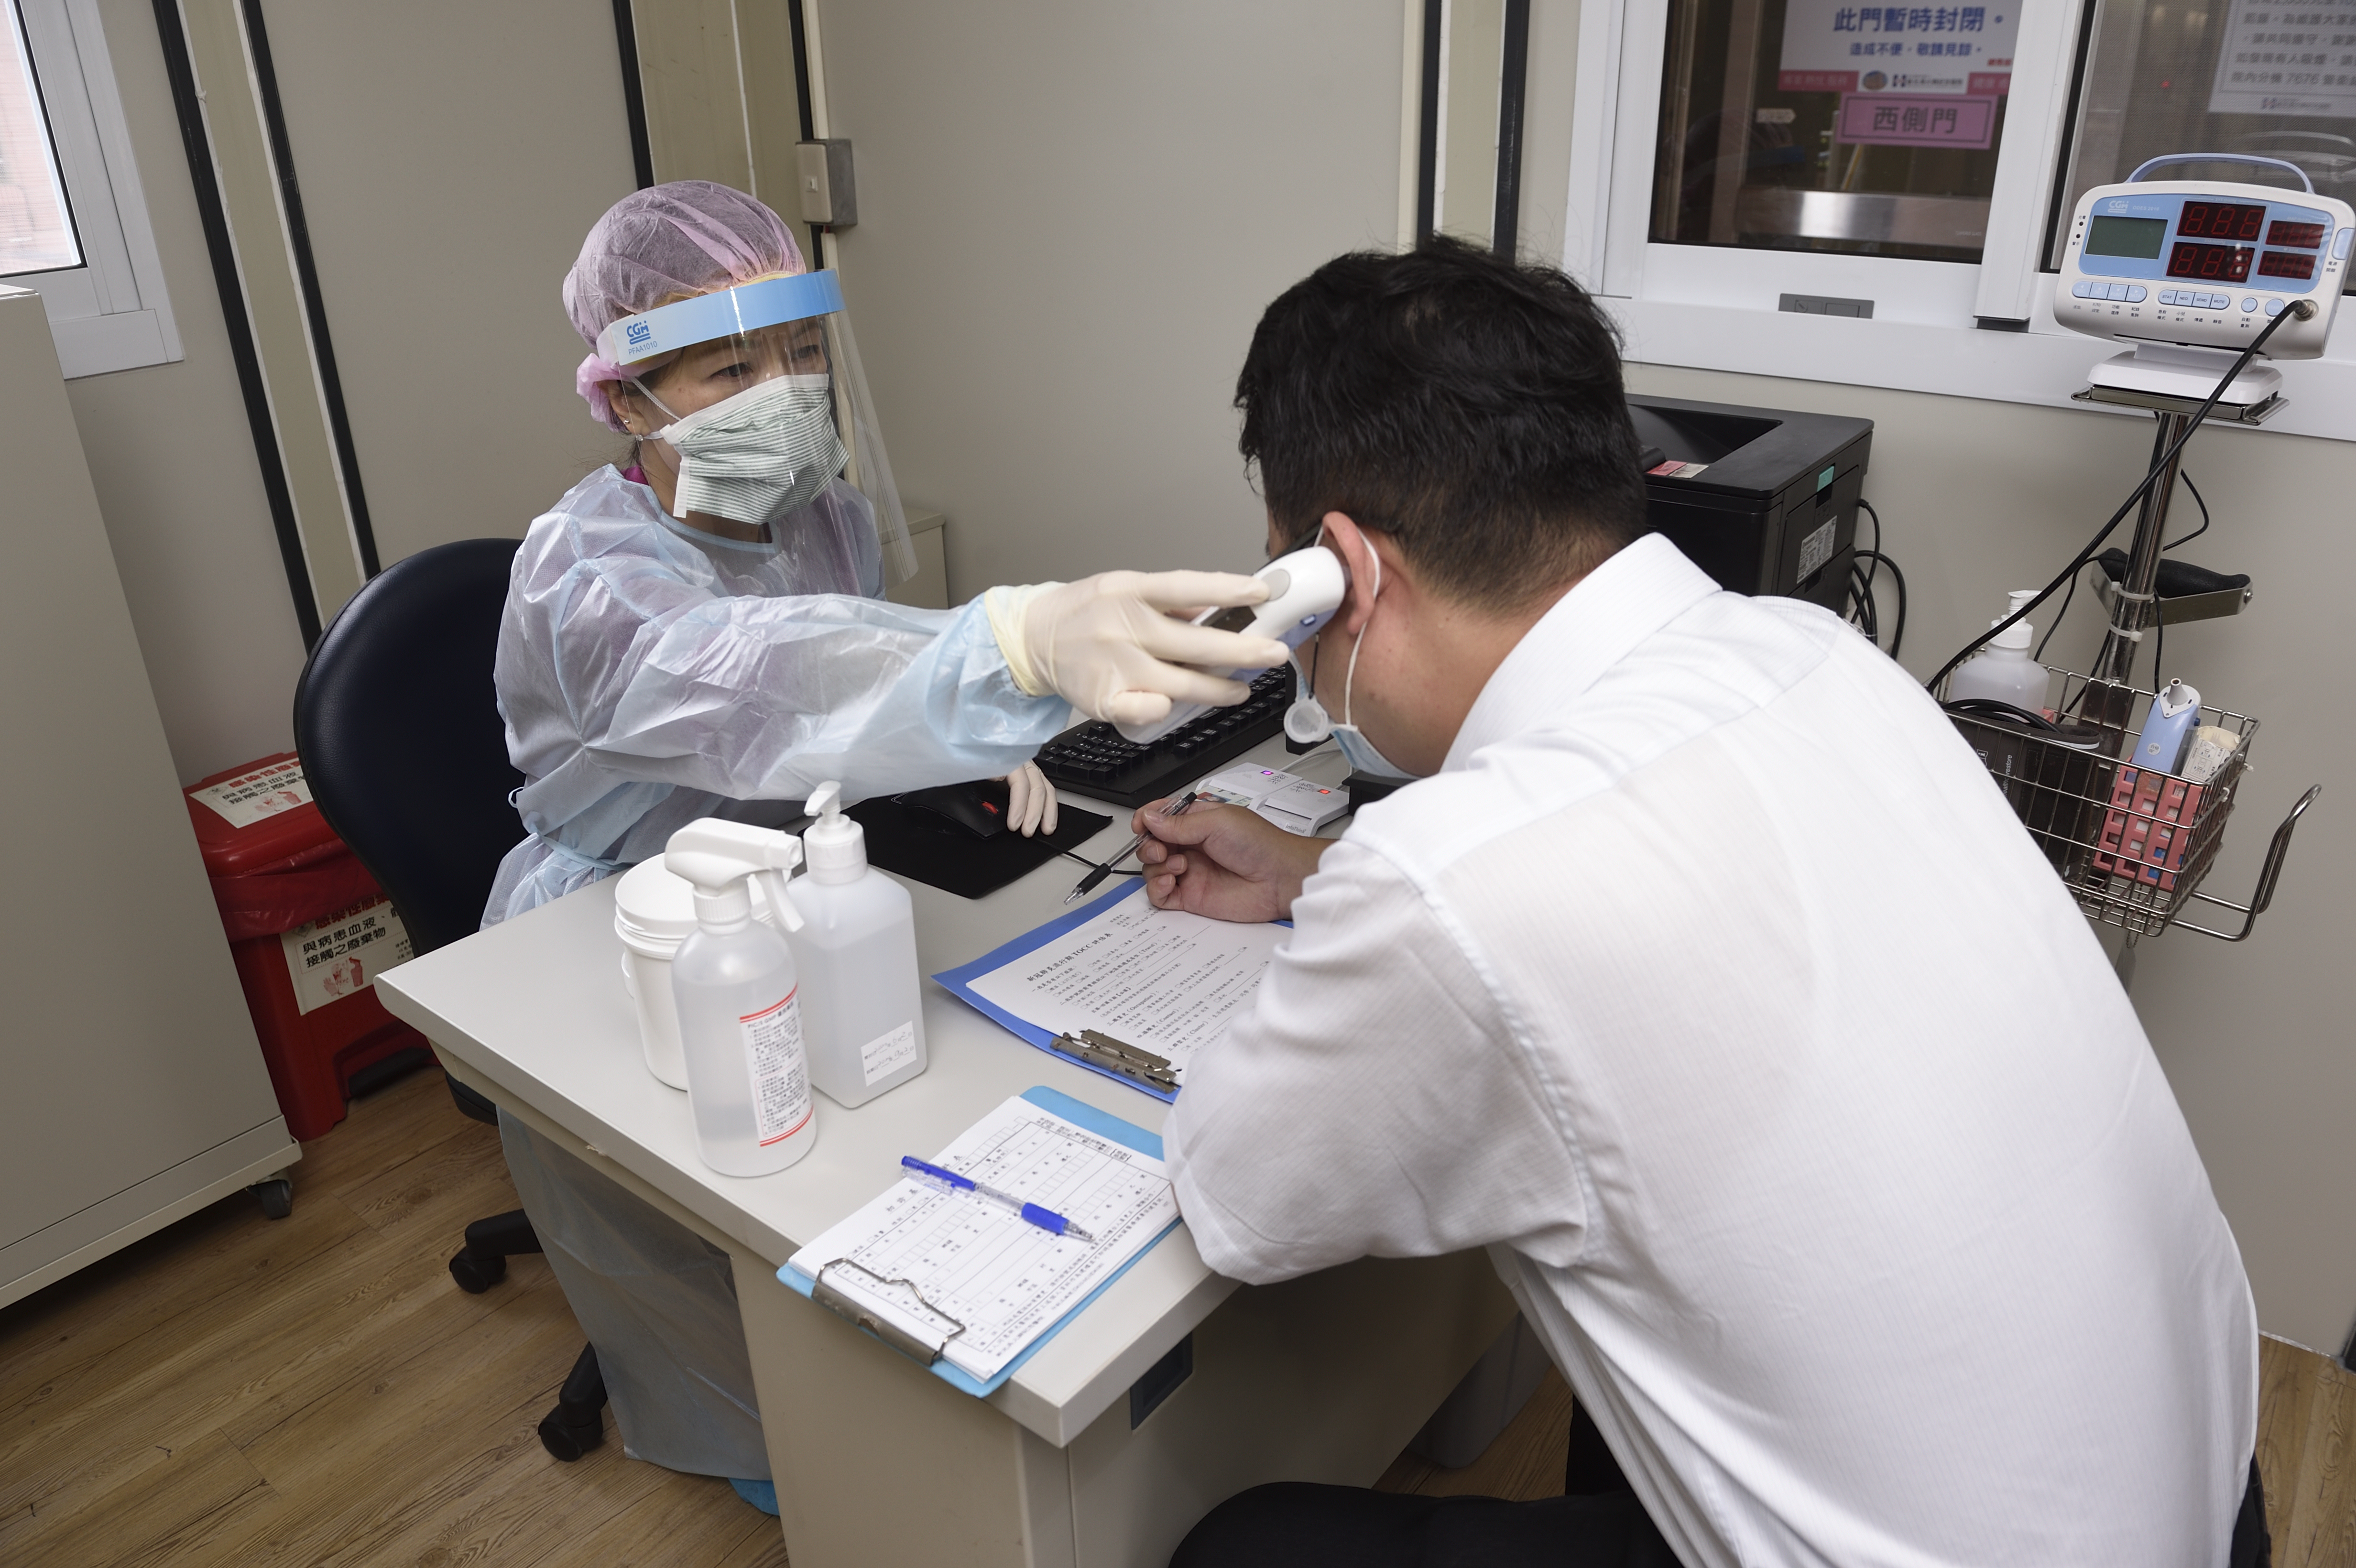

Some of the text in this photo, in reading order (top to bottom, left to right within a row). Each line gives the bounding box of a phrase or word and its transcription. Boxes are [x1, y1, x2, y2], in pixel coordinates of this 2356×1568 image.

[1833, 7, 2003, 32] 此門暫時封閉。
[1873, 107, 1958, 133] 西側門
[628, 341, 658, 356] PFAA1010
[306, 926, 386, 968] 接觸之廢棄物
[1070, 942, 1093, 958] TOCC
